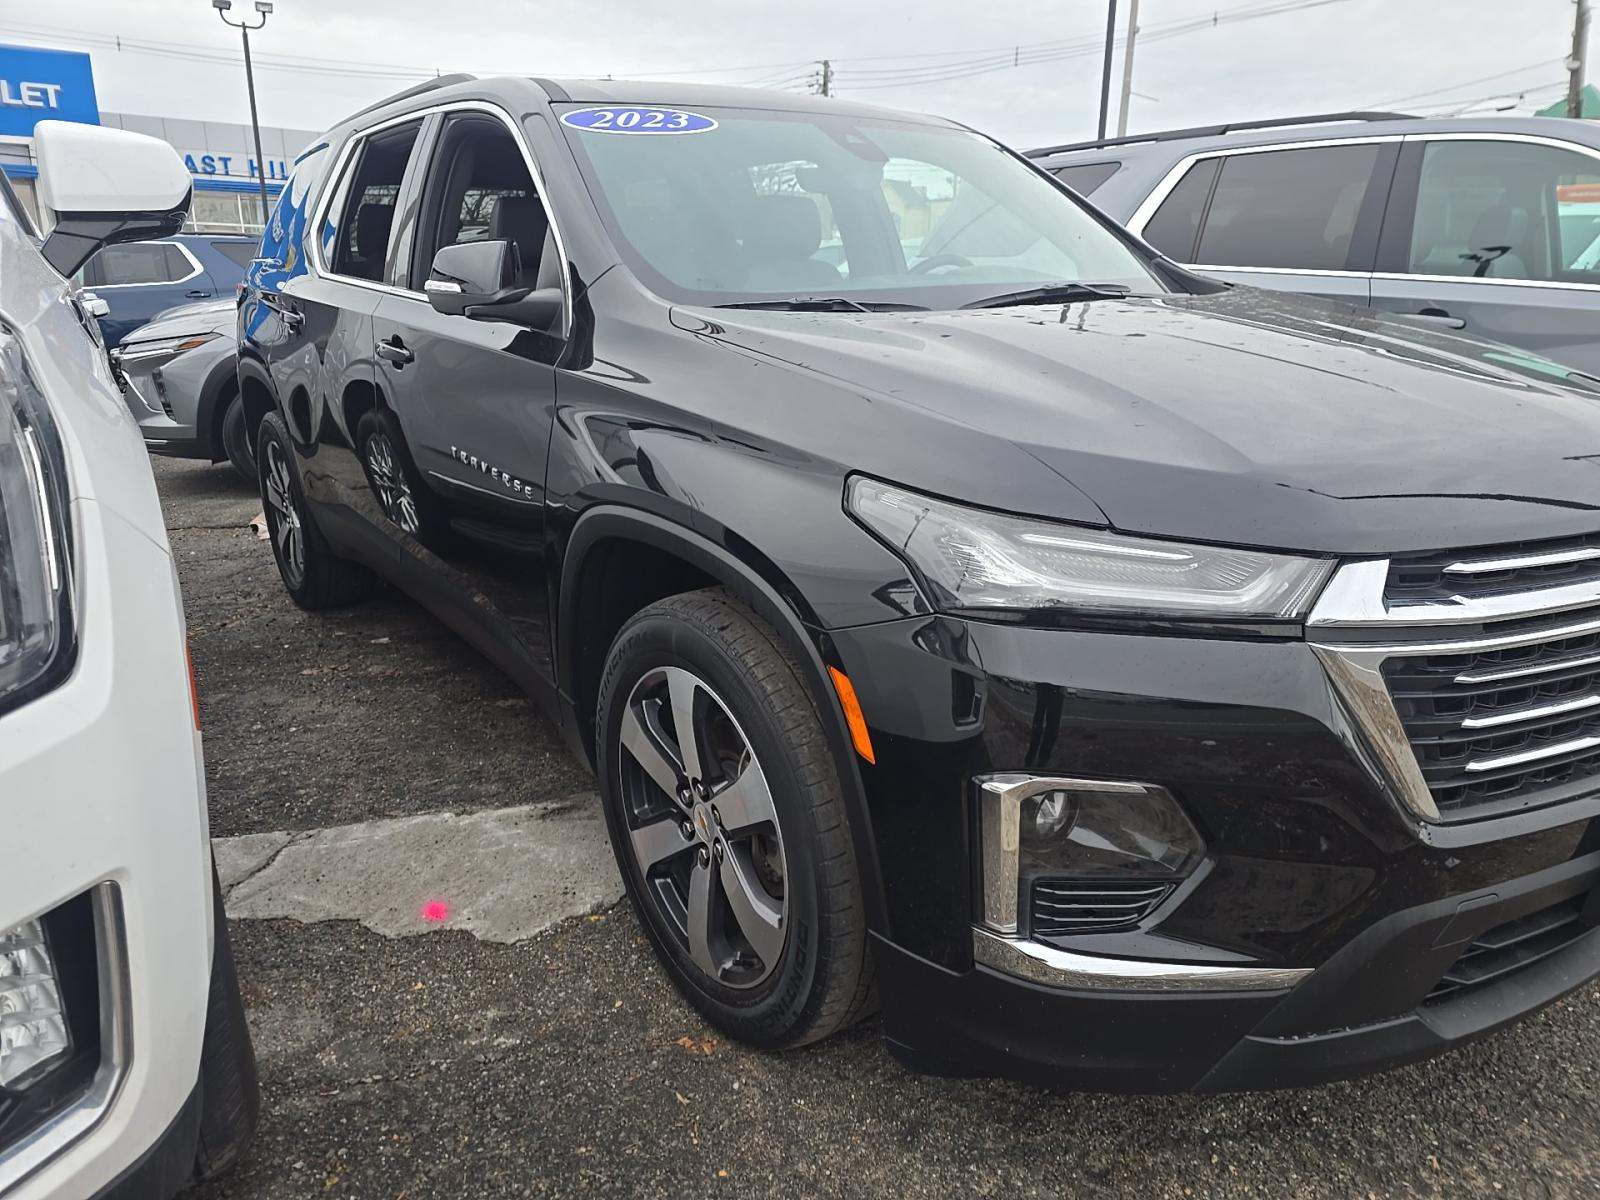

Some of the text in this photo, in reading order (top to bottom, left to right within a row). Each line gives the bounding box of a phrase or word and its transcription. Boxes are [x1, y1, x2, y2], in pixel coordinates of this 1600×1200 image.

[589, 110, 689, 129] 2023
[184, 154, 232, 176] AST
[451, 445, 533, 500] TRAVERSE
